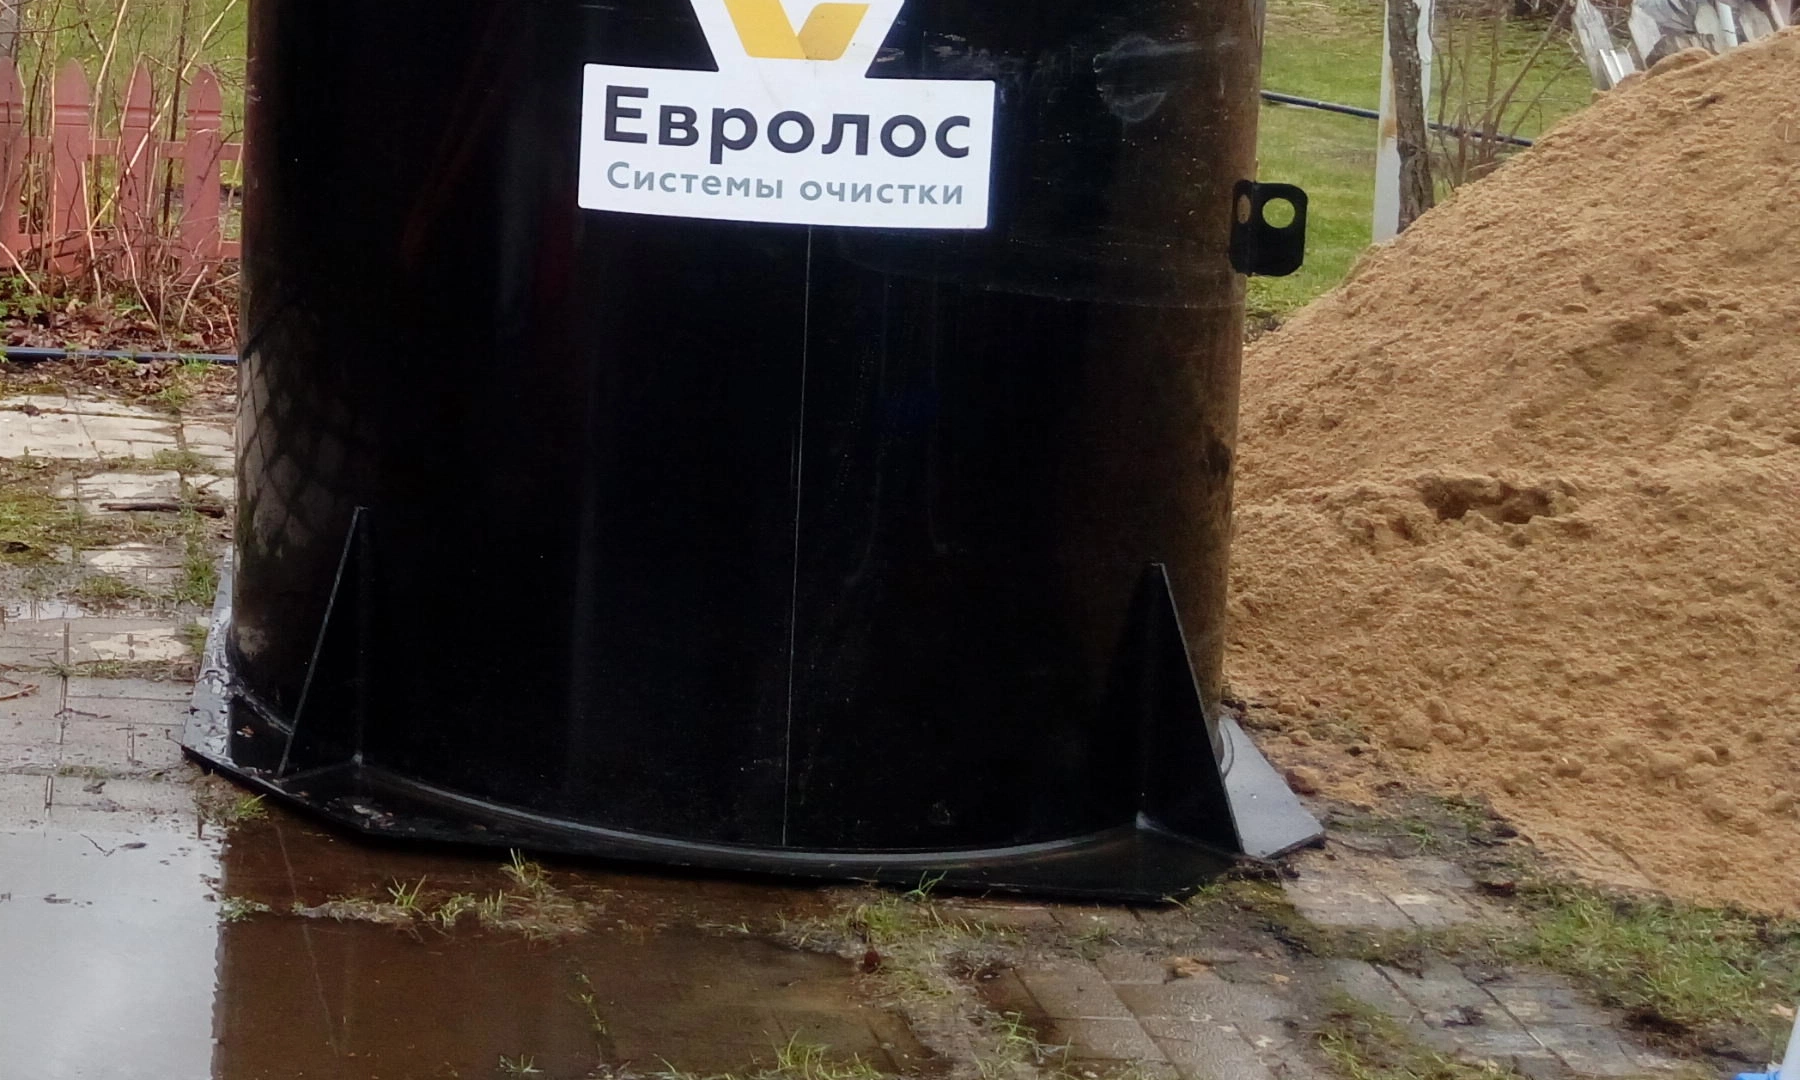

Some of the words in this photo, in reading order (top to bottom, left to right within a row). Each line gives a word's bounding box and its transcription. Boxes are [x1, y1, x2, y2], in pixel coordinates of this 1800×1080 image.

[604, 85, 970, 164] Евролос
[607, 162, 783, 199] Системы
[800, 180, 963, 205] очистки
